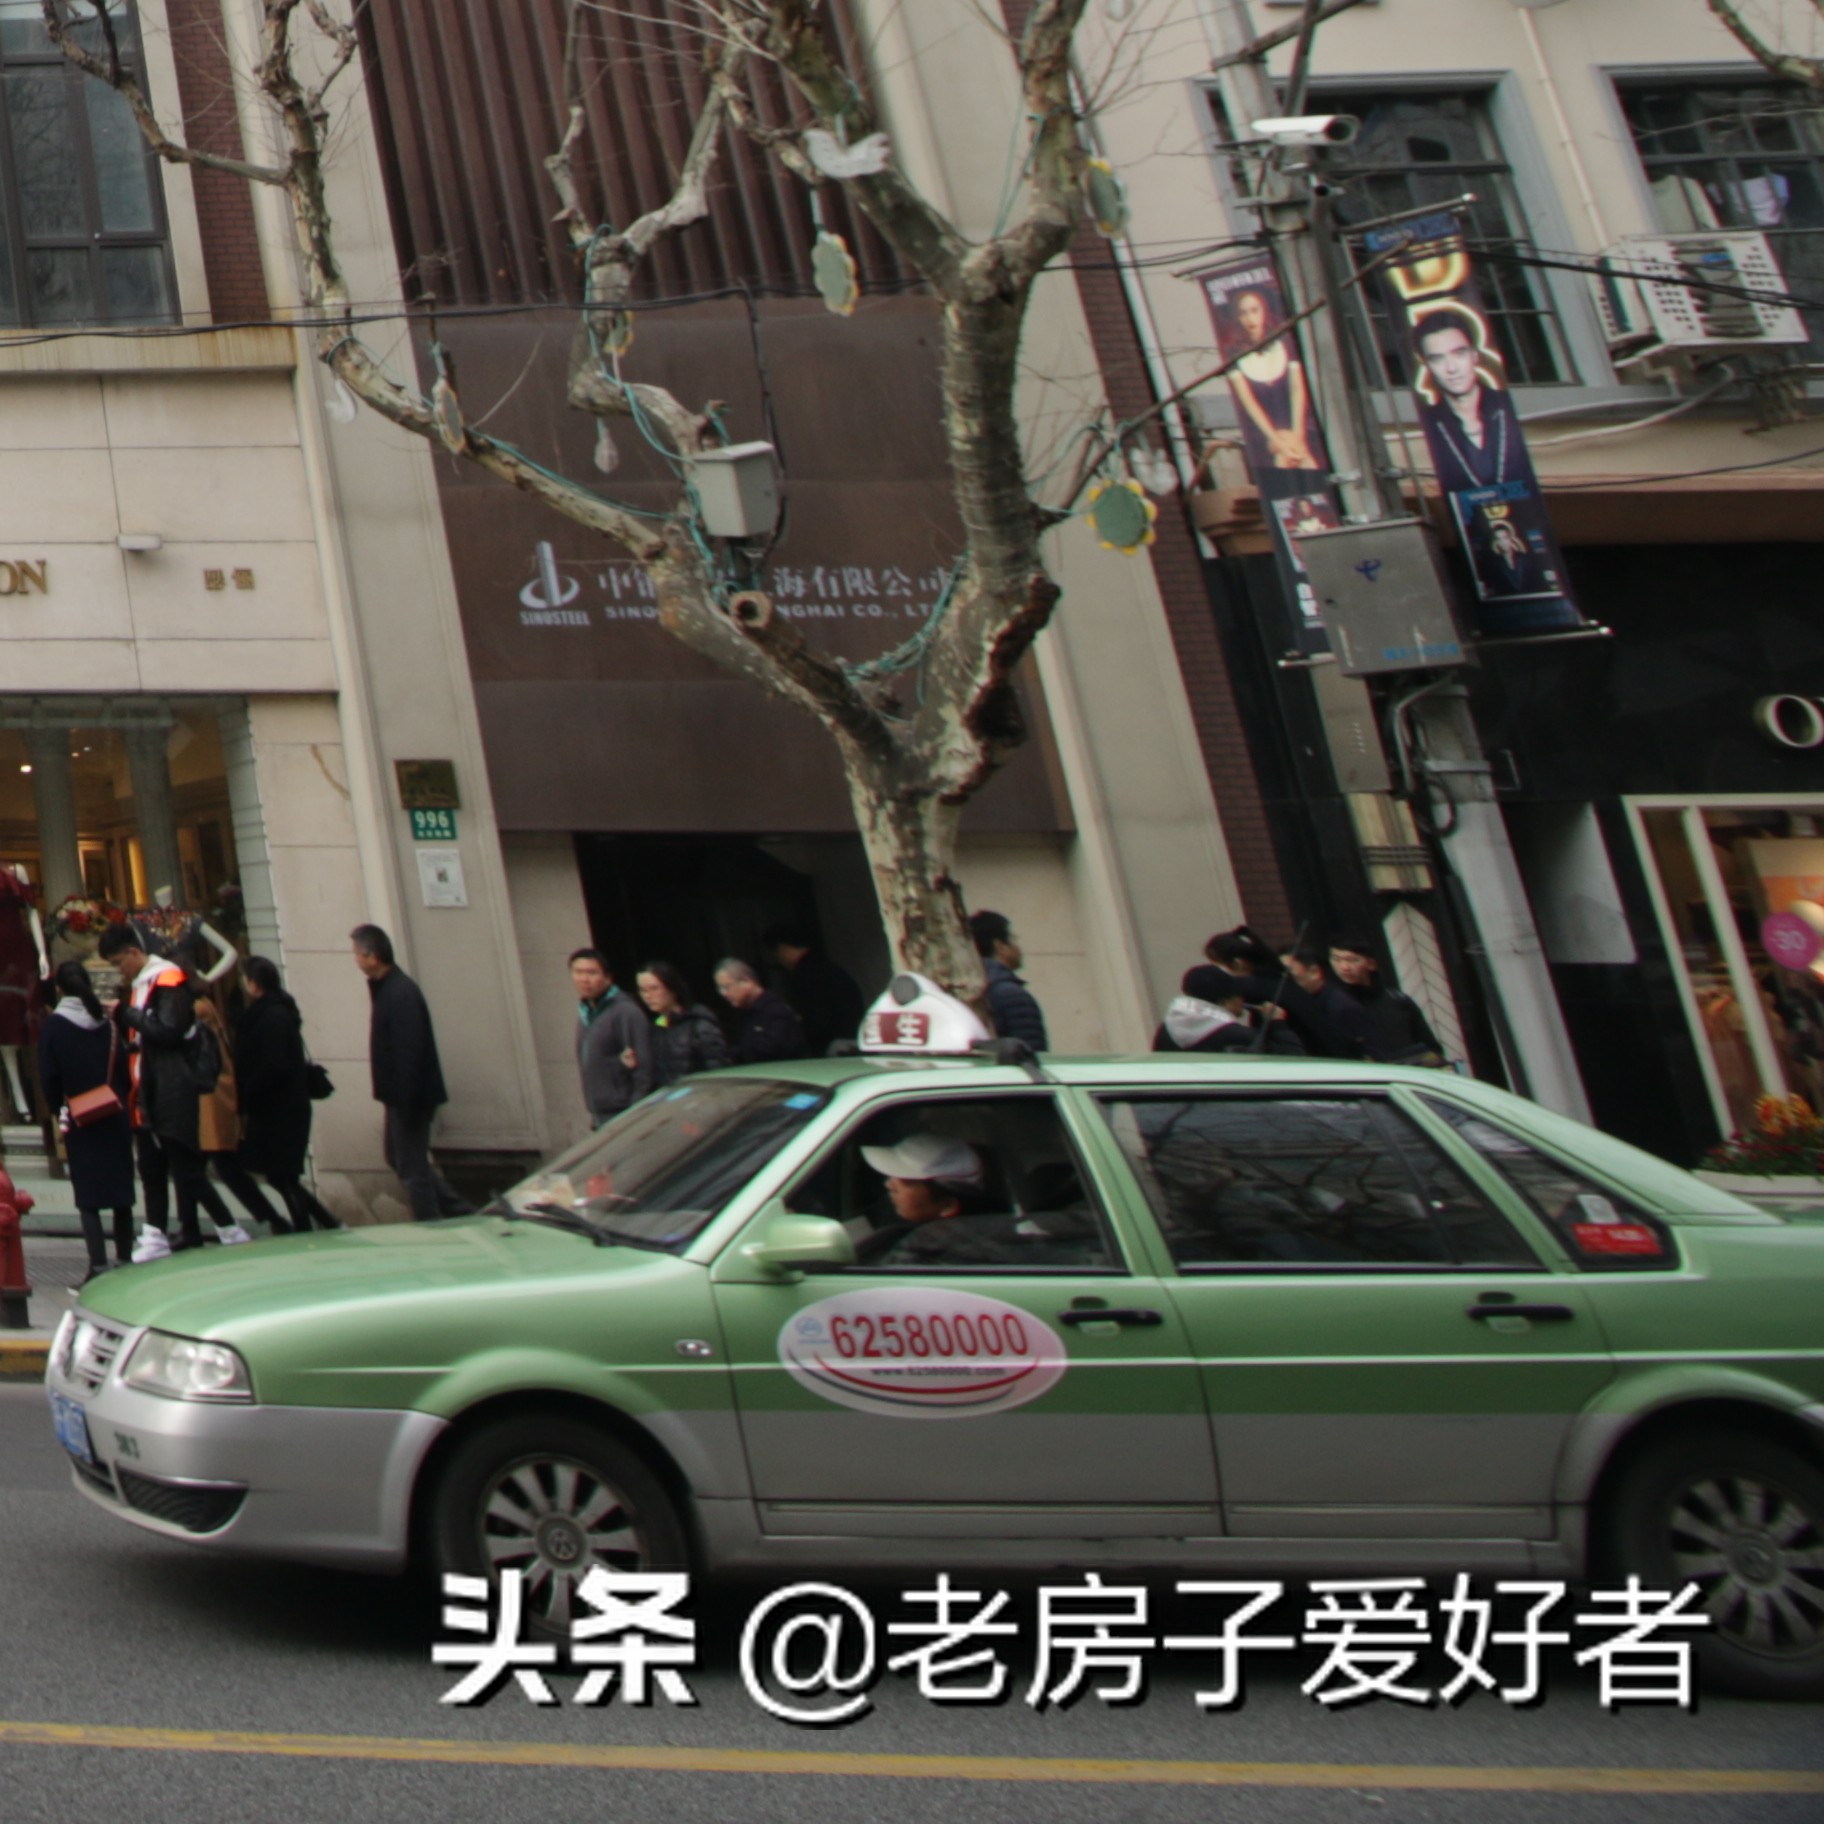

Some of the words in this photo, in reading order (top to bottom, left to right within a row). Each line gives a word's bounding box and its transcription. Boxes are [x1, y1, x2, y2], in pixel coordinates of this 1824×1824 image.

[520, 610, 591, 626] SINOSTEEL
[414, 811, 449, 828] 996
[830, 1314, 1028, 1358] 62580000
